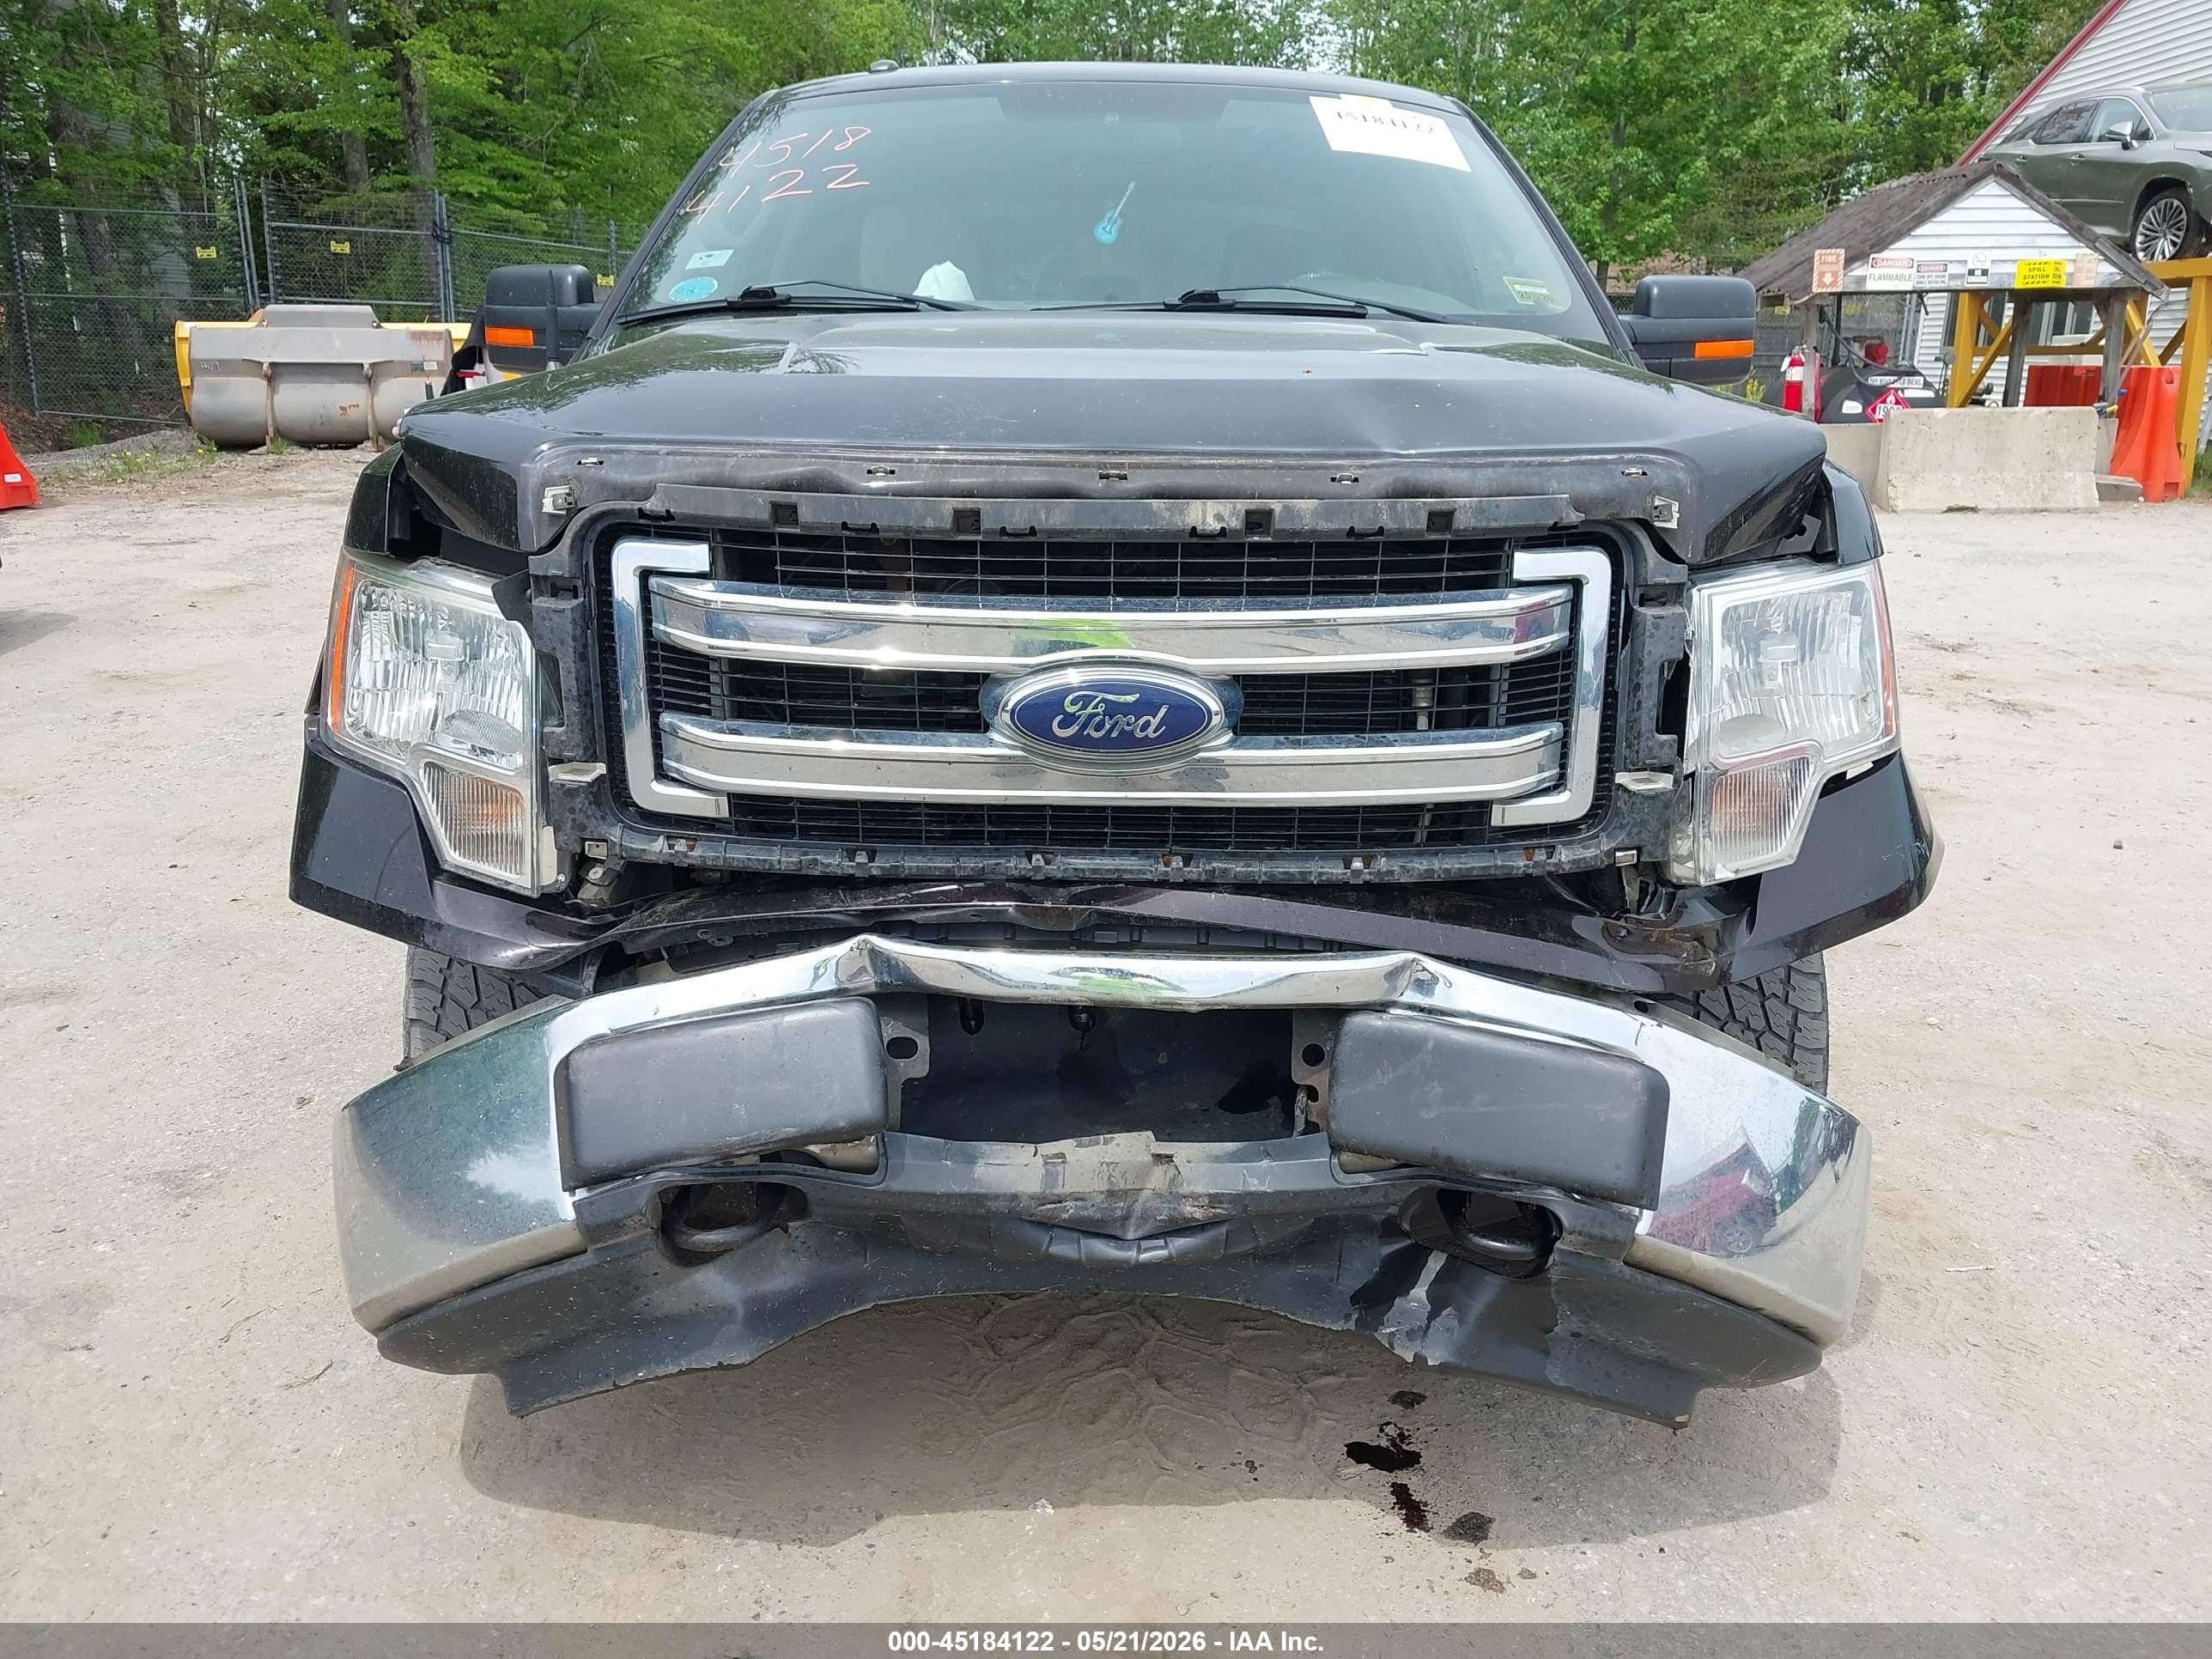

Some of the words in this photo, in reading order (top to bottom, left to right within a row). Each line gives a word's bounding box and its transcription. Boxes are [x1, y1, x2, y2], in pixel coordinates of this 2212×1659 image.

[719, 126, 872, 179] 4518
[686, 164, 870, 226] 4122
[1876, 258, 1908, 267] DANGER
[1869, 273, 1912, 282] FLAMMABLE
[1906, 377, 1922, 386] DIESEL
[1052, 690, 1170, 738] Ford
